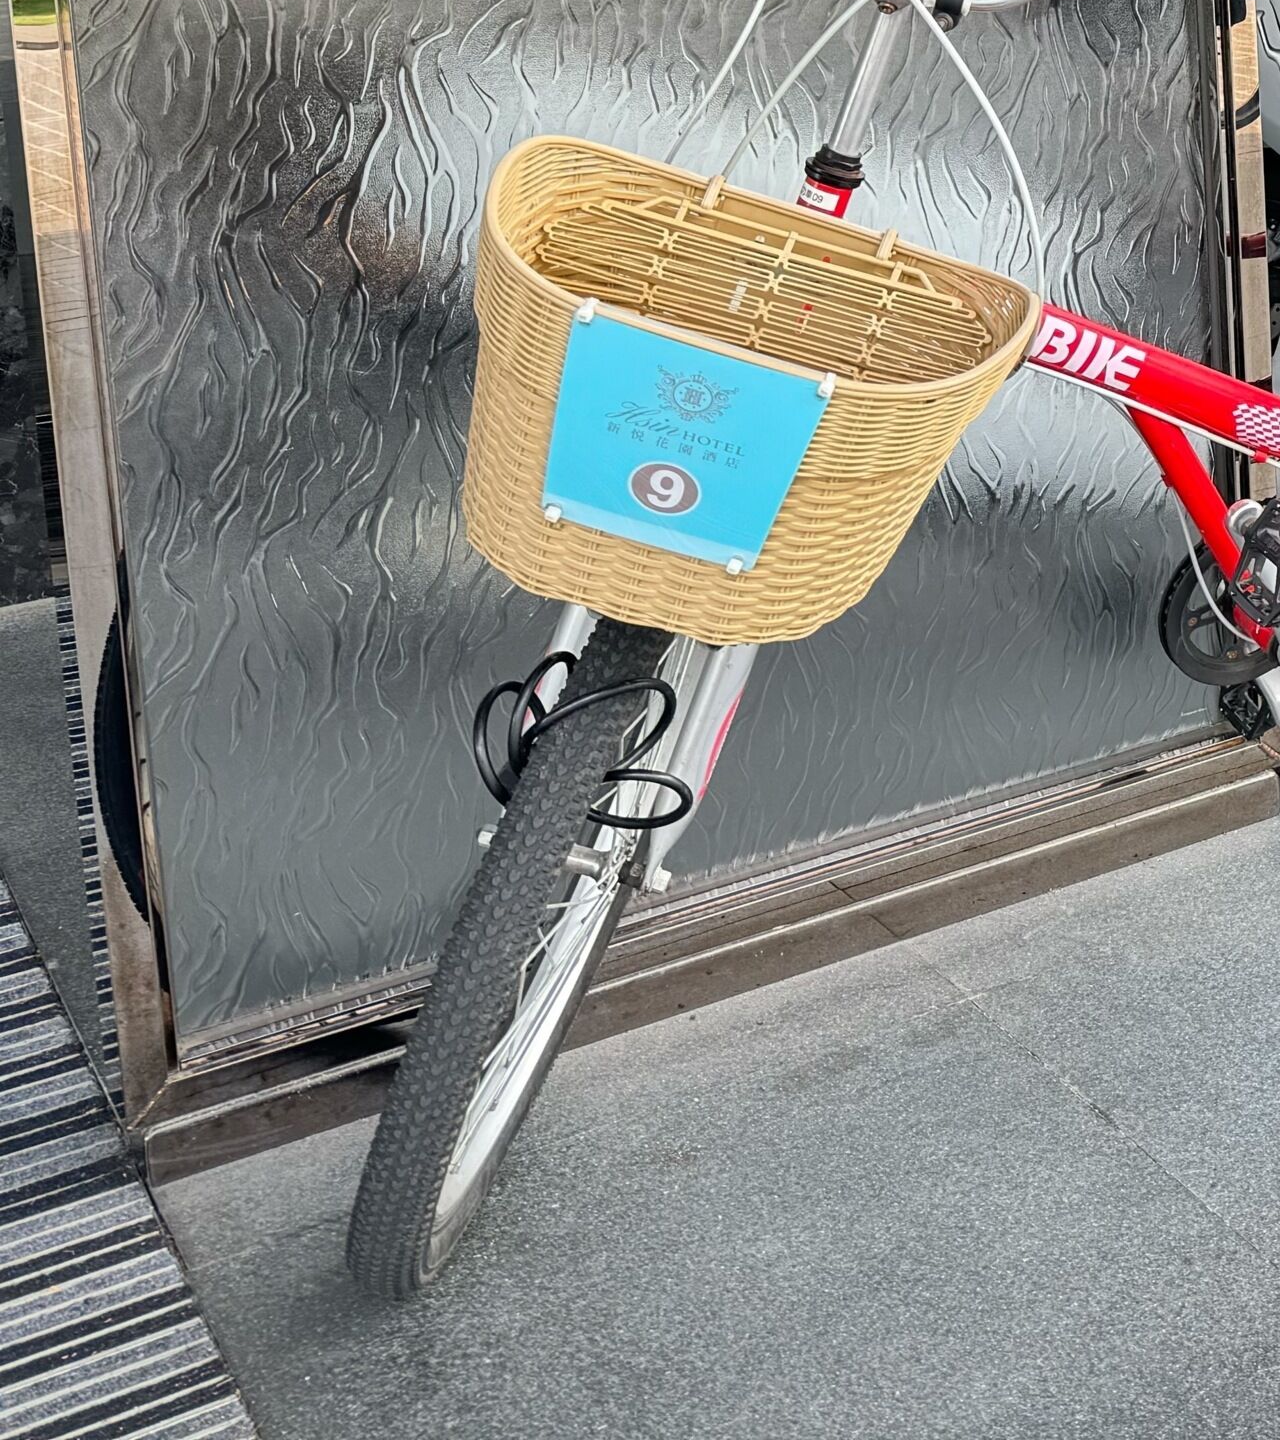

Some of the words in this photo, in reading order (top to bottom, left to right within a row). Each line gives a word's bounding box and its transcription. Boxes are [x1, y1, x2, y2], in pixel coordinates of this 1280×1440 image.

[1029, 314, 1147, 392] BIKE
[604, 401, 682, 437] Hsin
[682, 430, 746, 457] HOTEL
[646, 469, 686, 508] 9
